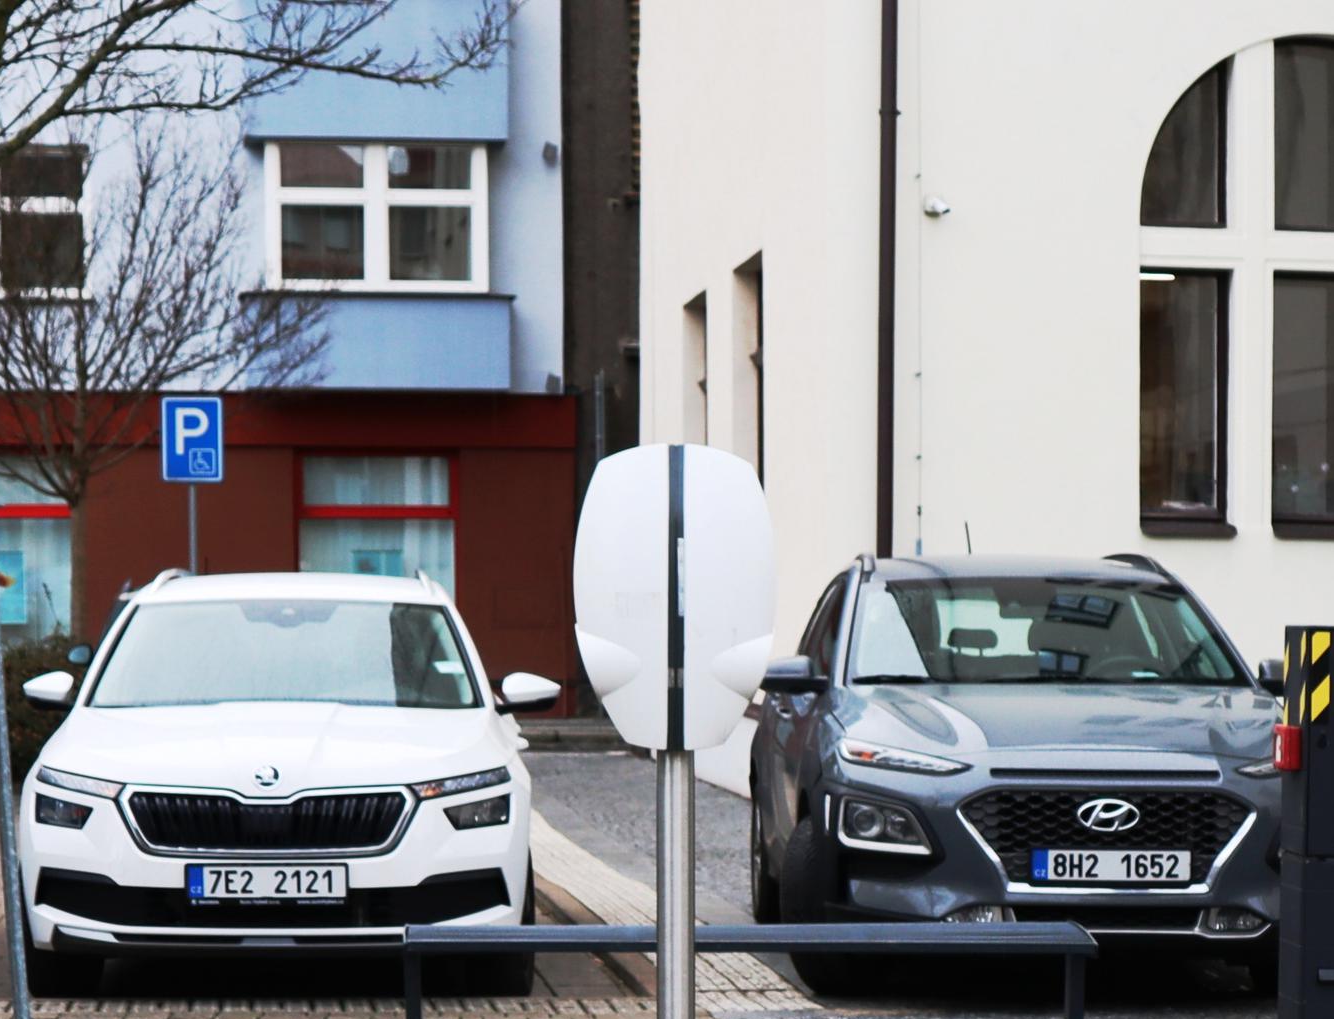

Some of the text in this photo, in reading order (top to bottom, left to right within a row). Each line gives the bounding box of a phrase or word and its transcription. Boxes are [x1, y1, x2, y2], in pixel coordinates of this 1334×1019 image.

[174, 407, 210, 455] P
[1034, 869, 1047, 877] CZ
[1053, 853, 1180, 879] 8H2 1652
[189, 886, 203, 894] CZ
[208, 870, 333, 894] 7E2 2121
